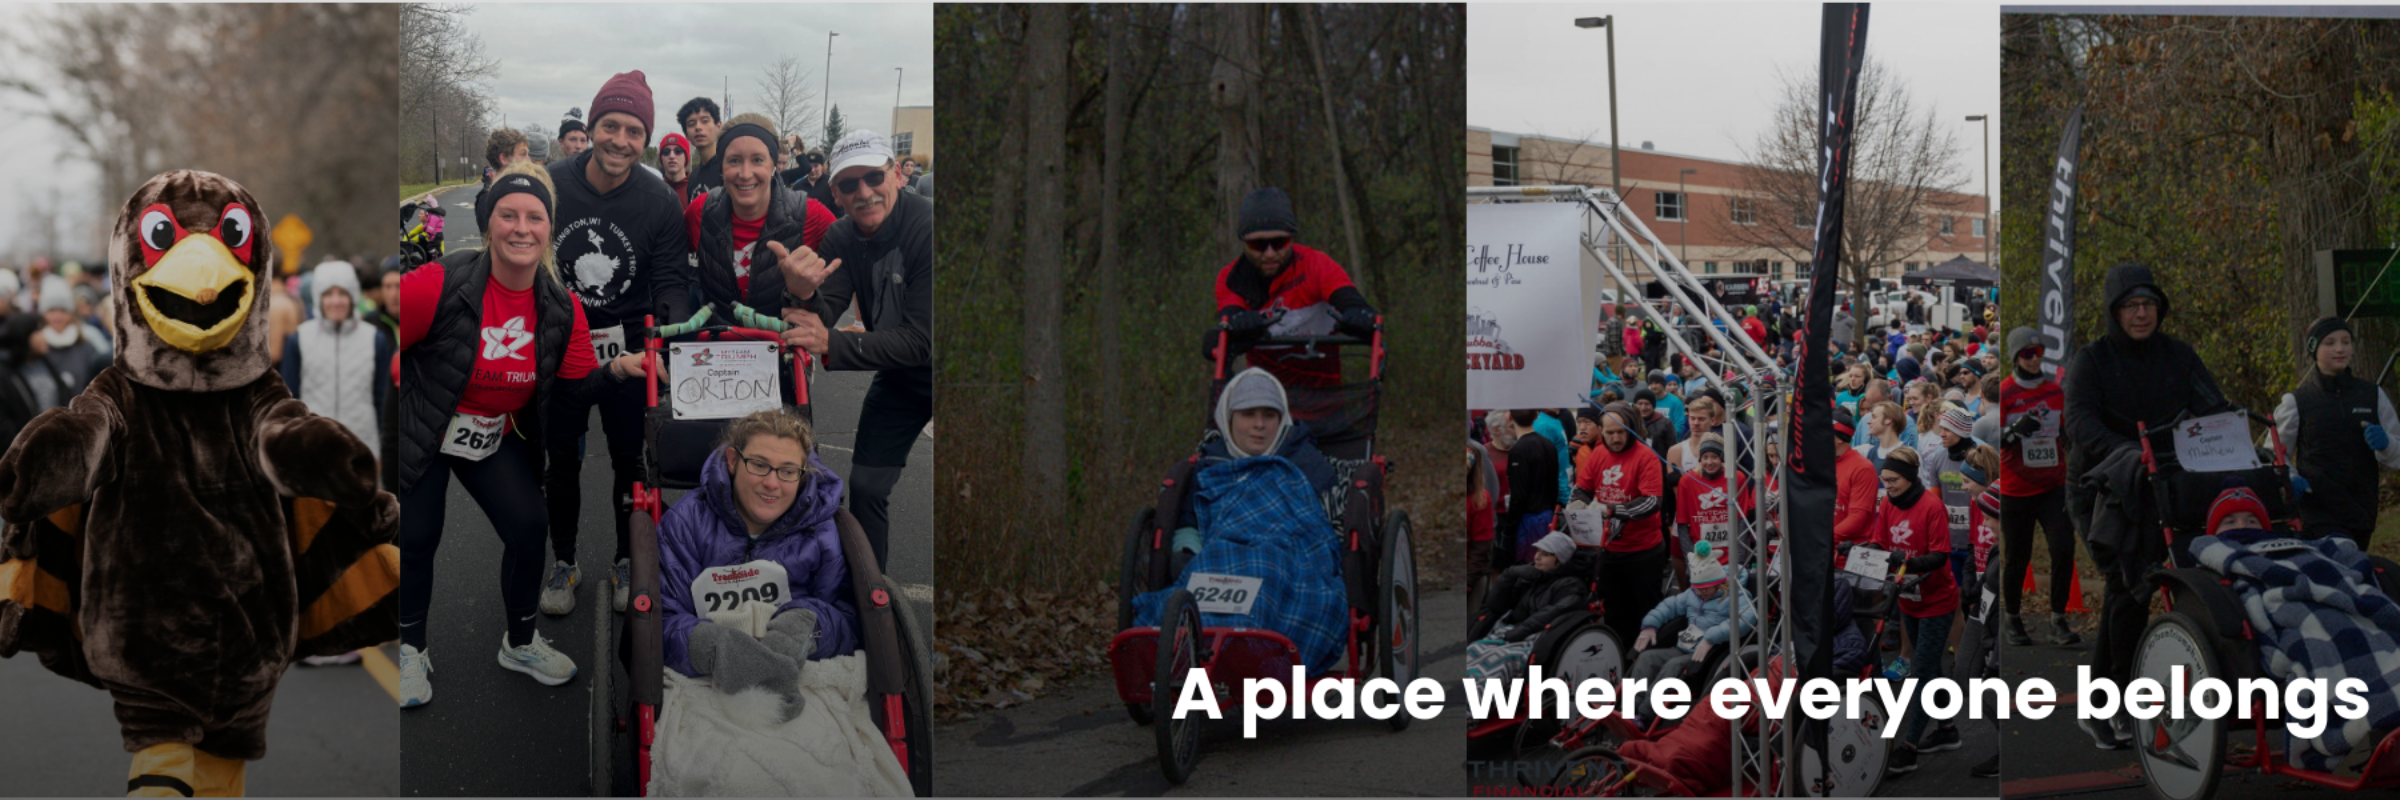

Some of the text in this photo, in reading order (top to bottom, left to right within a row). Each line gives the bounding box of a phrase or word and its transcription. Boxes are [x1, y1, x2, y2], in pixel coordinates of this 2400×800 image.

[608, 221, 634, 253] TURKEY
[627, 254, 637, 277] TROT
[1498, 243, 1550, 273] House
[1466, 335, 1502, 350] ubba's
[707, 368, 740, 378] Captain
[677, 373, 775, 404] ORION
[2027, 447, 2056, 461] 6238
[704, 582, 779, 612] 2209
[1193, 586, 1248, 604] 6240
